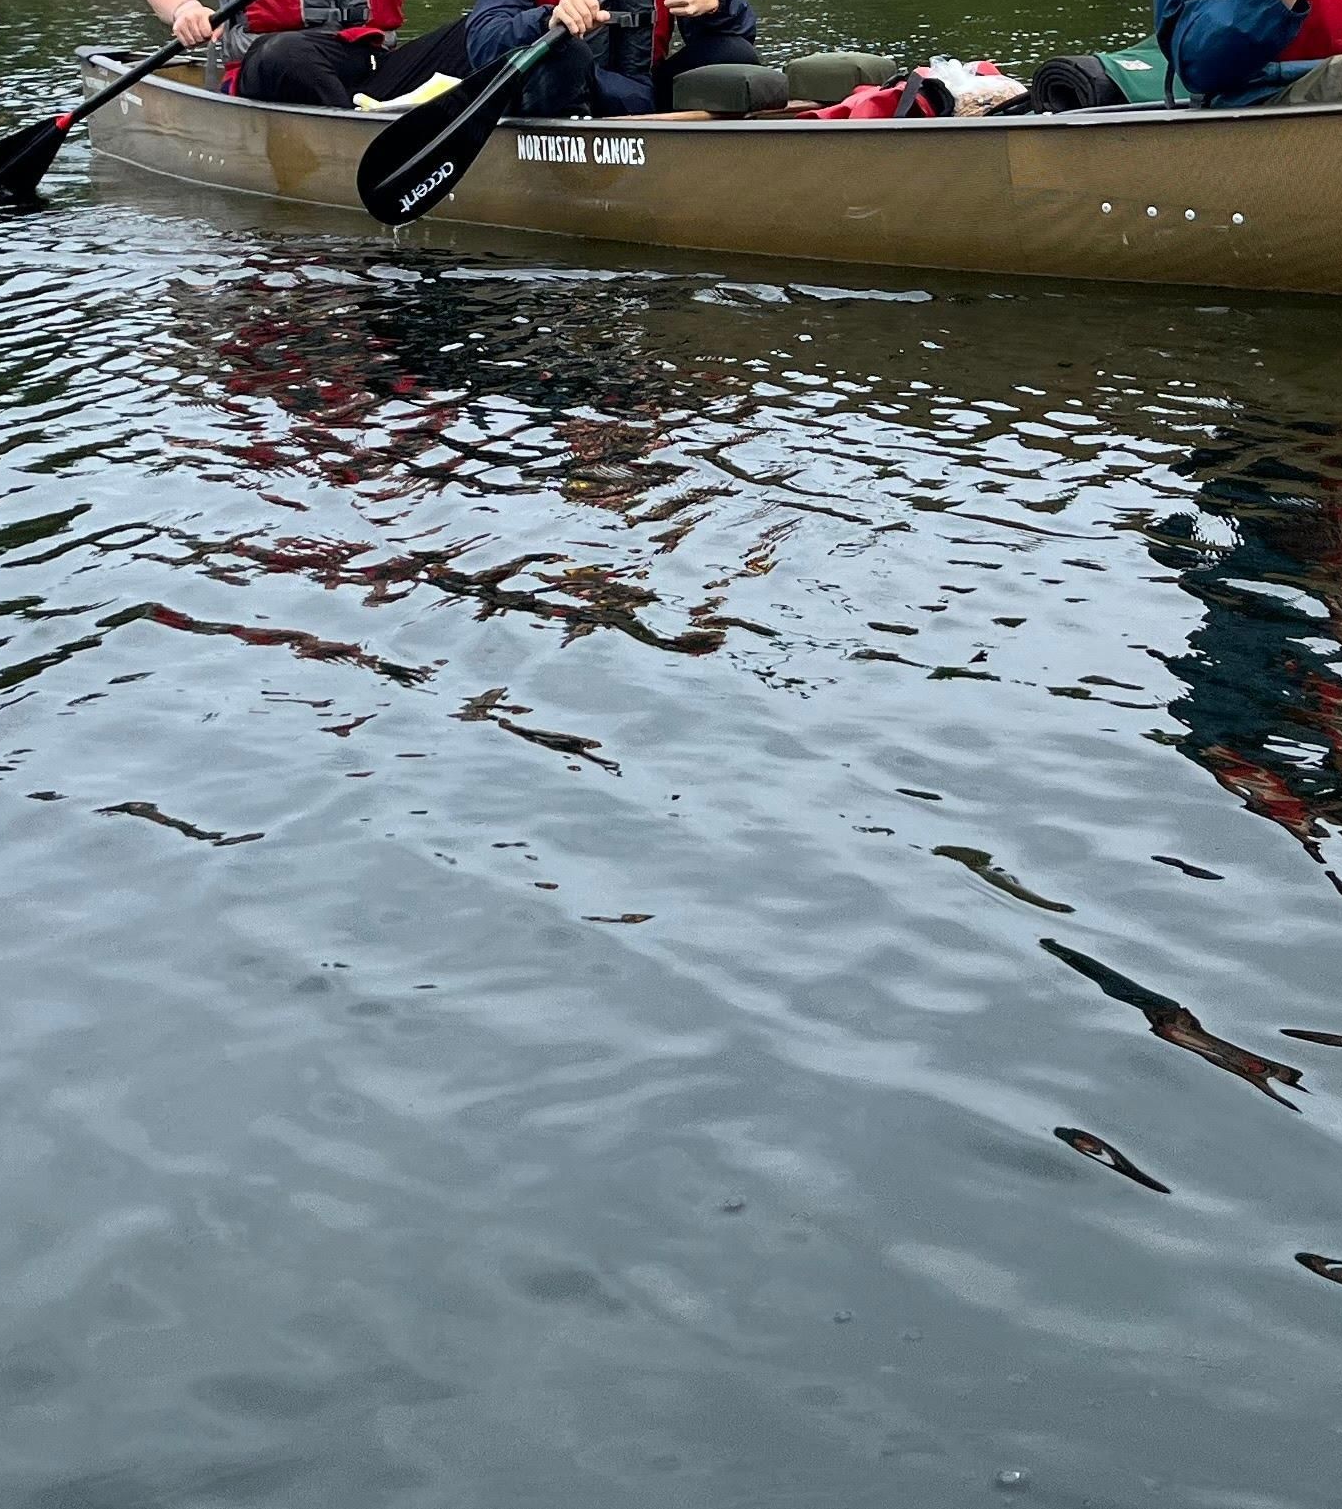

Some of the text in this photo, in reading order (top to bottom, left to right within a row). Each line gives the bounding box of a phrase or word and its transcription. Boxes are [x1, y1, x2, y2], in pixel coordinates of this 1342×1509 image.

[517, 134, 645, 165] NORTHSTAR CANOES
[399, 161, 454, 213] accent
